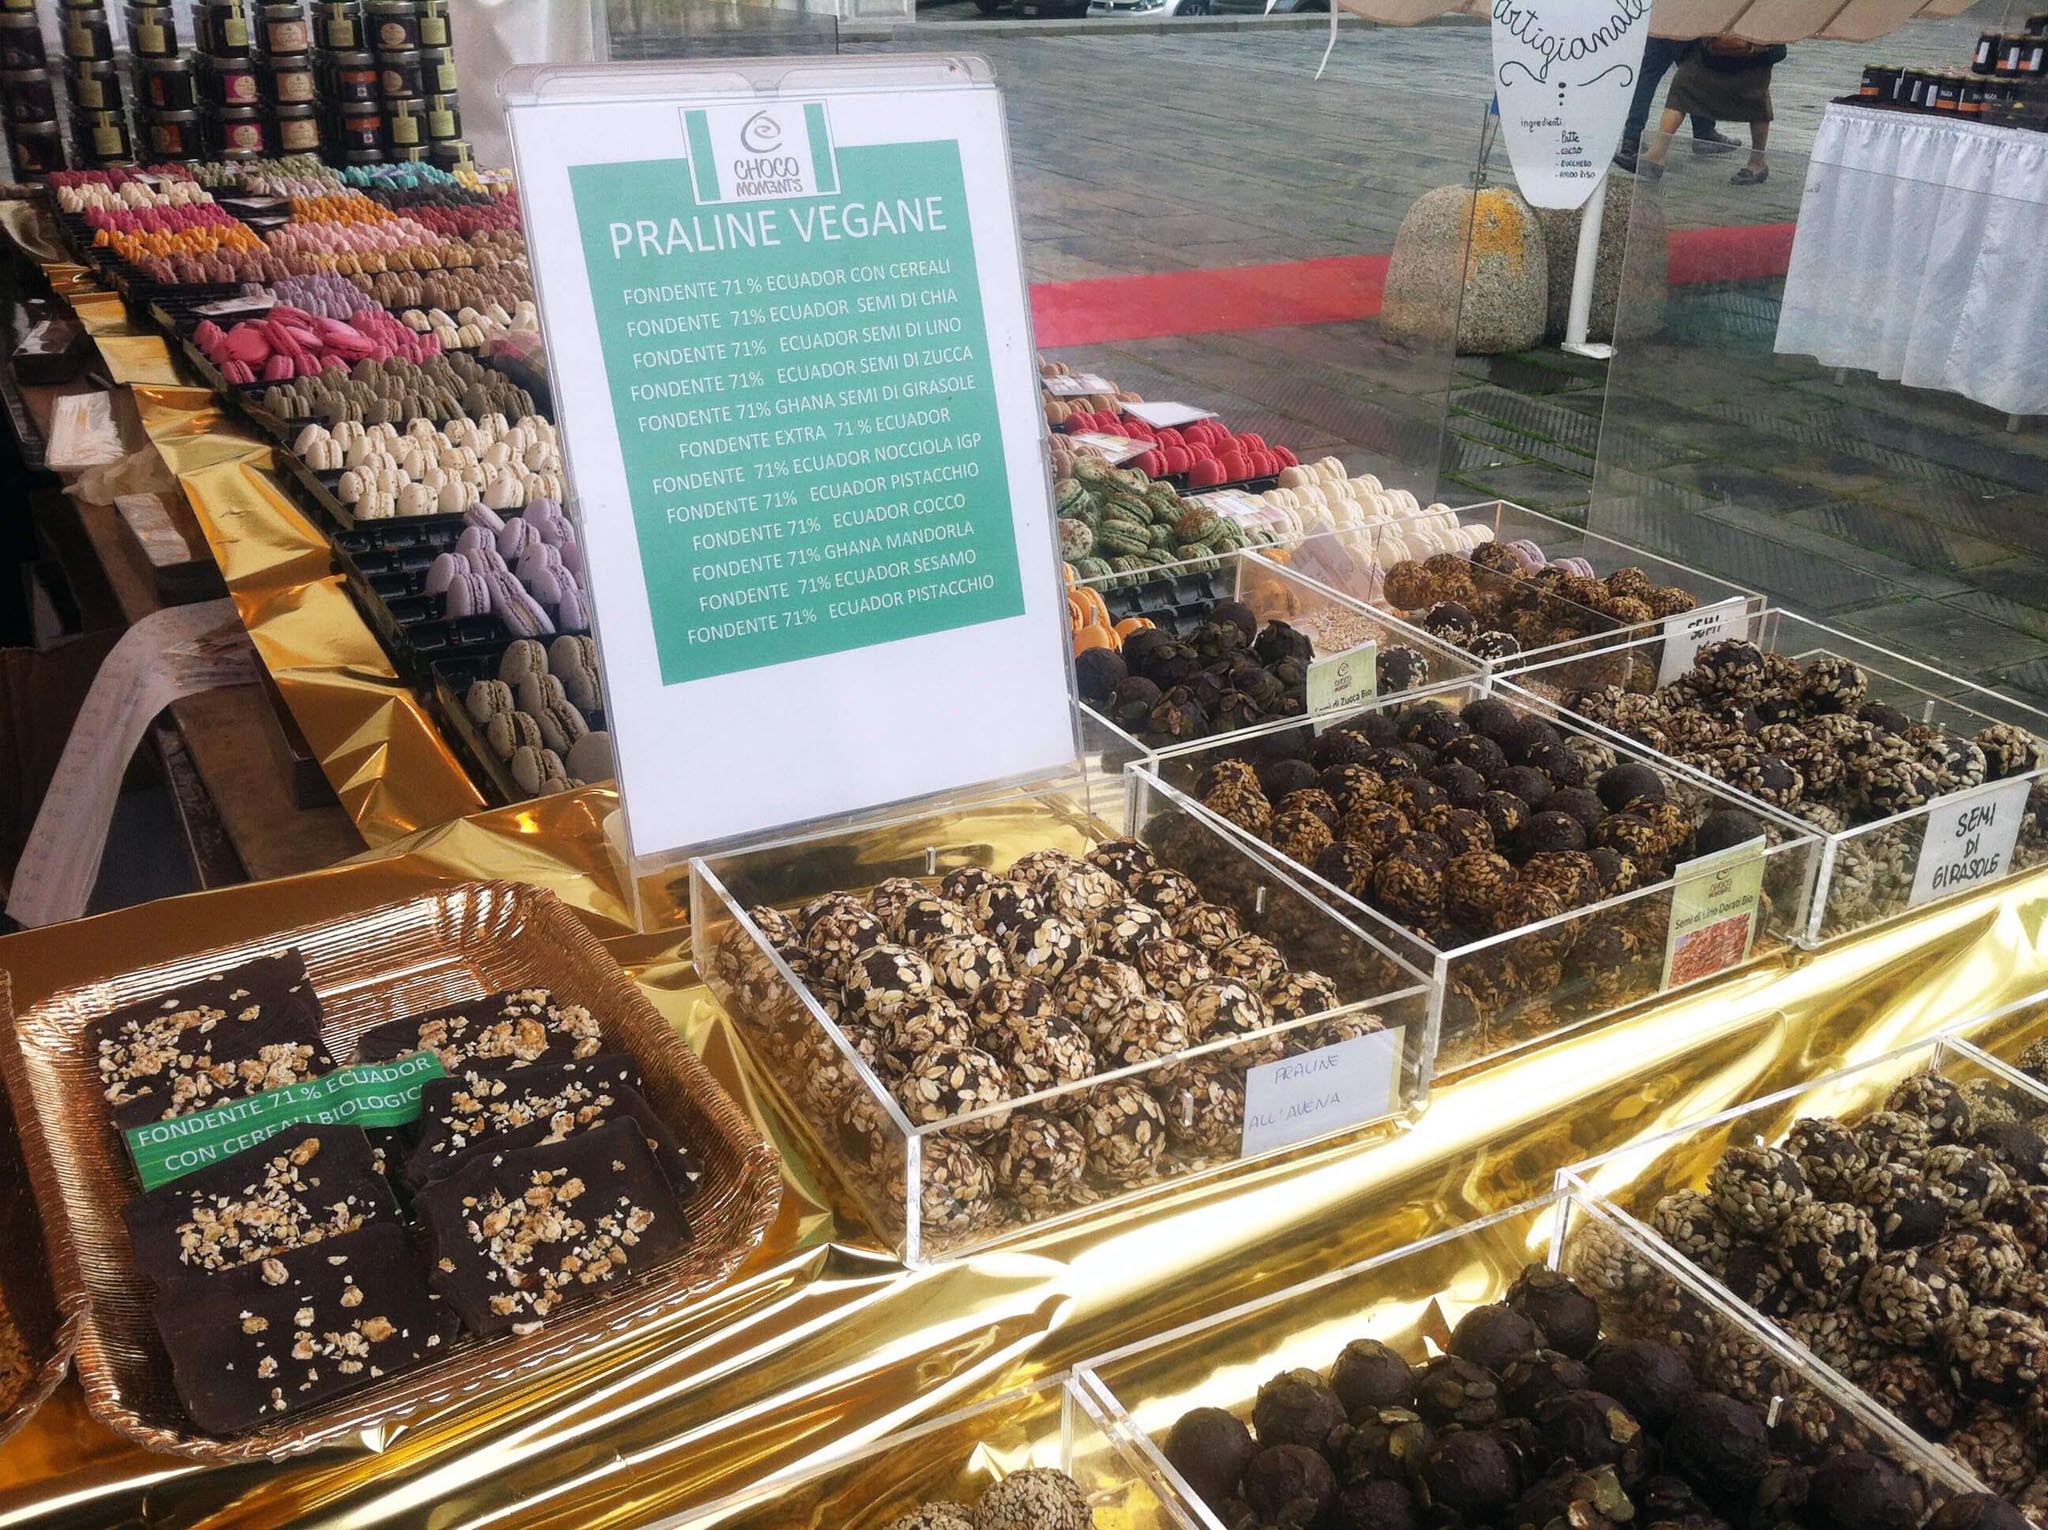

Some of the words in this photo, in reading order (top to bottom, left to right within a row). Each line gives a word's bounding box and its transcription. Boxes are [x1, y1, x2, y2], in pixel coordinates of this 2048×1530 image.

[734, 157, 800, 180] CHOCO
[609, 210, 781, 259] PRALINE
[789, 196, 947, 242] VEGANE
[624, 282, 718, 305] FONDENTE
[767, 269, 846, 291] ECUADOR
[851, 266, 885, 282] CON
[890, 259, 950, 278] CEREALI
[627, 313, 721, 337] FONDENTE
[730, 309, 765, 326] 71%
[770, 300, 849, 322] ECUADOR
[857, 295, 896, 312] SEMI
[900, 292, 916, 307] DI
[921, 289, 957, 305] CHIA
[633, 344, 726, 368] FONDENTE
[731, 340, 766, 357] 71%
[780, 330, 858, 352] ECUADOR
[863, 325, 900, 342] SEMI
[906, 322, 921, 337] DI
[926, 318, 961, 335] LINO
[631, 376, 724, 401] FONDENTE
[728, 371, 764, 389] 71%
[777, 360, 856, 383] ECUADOR
[860, 355, 898, 373] SEMI
[903, 352, 918, 367] DI
[923, 346, 973, 365] ZUCCA
[639, 407, 732, 432] FONDENTE
[736, 402, 771, 419] 71%
[776, 393, 835, 414] GHANA
[839, 387, 877, 406] SEMI
[882, 385, 898, 400] DI
[903, 375, 975, 397] GIRASOLE
[680, 433, 770, 459] FONDENTE
[775, 425, 826, 445] EXTRA
[876, 408, 950, 431] ECUADOR
[653, 467, 745, 494] FONDENTE
[754, 461, 789, 479] 71%
[793, 450, 870, 474] ECUADOR
[875, 437, 953, 461] NOCCIOLA
[957, 433, 981, 449] IGP
[667, 496, 758, 523] FONDENTE
[763, 491, 797, 509] 71%
[810, 477, 886, 501] ECUADOR
[891, 462, 978, 488] PISTACCHIO
[693, 523, 783, 551] FONDENTE
[787, 517, 821, 535] 71%
[834, 503, 909, 528] ECUADOR
[914, 493, 965, 514] COCCO
[693, 553, 783, 582] FONDENTE
[787, 547, 821, 566] 71%
[825, 537, 882, 559] GHANA
[886, 521, 974, 549] MANDORLA
[699, 583, 789, 612] FONDENTE
[798, 576, 831, 594] 71%
[835, 562, 911, 587] ECUADOR
[914, 549, 976, 573] SESAMO
[688, 615, 778, 644] FONDENTE
[782, 609, 817, 627] 71%
[829, 592, 904, 619] ECUADOR
[908, 575, 994, 603] PISTACCHIO
[1956, 802, 1997, 838] SEMI
[1963, 833, 1980, 858] DI
[1932, 853, 2001, 890] GIRASOLE
[1675, 915, 1693, 929] Semi
[1274, 1054, 1340, 1085] PRALINE
[138, 1099, 264, 1147] FONDENTE
[326, 1056, 432, 1094] ECUADOR
[165, 1144, 217, 1171] CON
